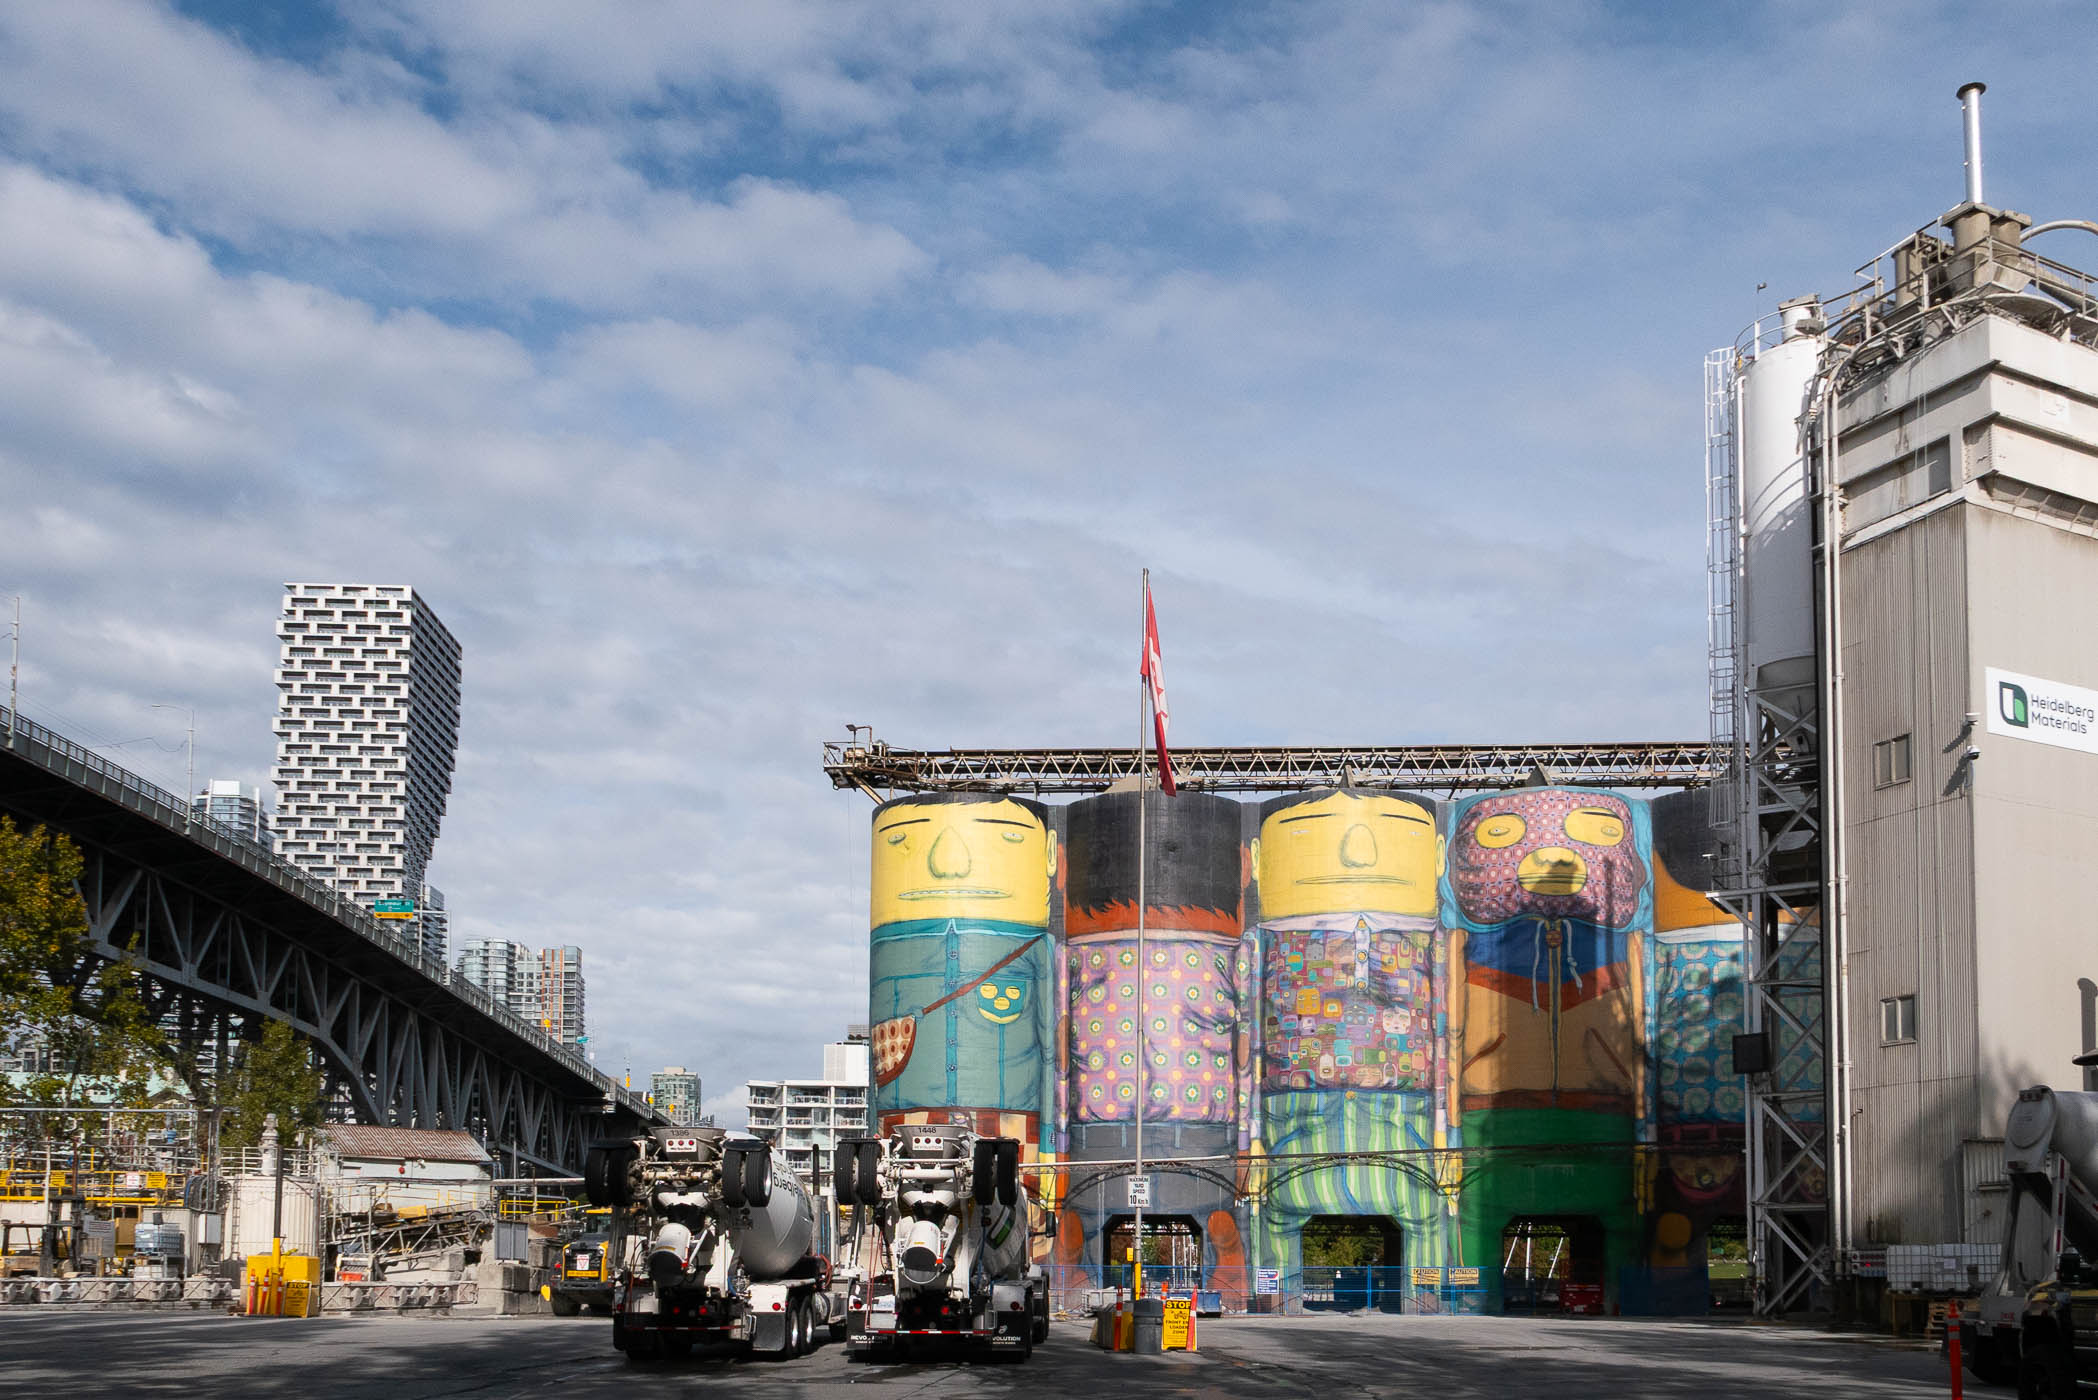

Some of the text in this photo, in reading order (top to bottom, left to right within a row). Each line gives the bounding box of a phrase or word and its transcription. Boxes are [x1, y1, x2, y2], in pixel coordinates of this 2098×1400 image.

[2030, 694, 2095, 722] Heidelberg
[2031, 711, 2087, 734] Materials
[918, 1126, 937, 1134] 1448
[1130, 1195, 1137, 1204] 10
